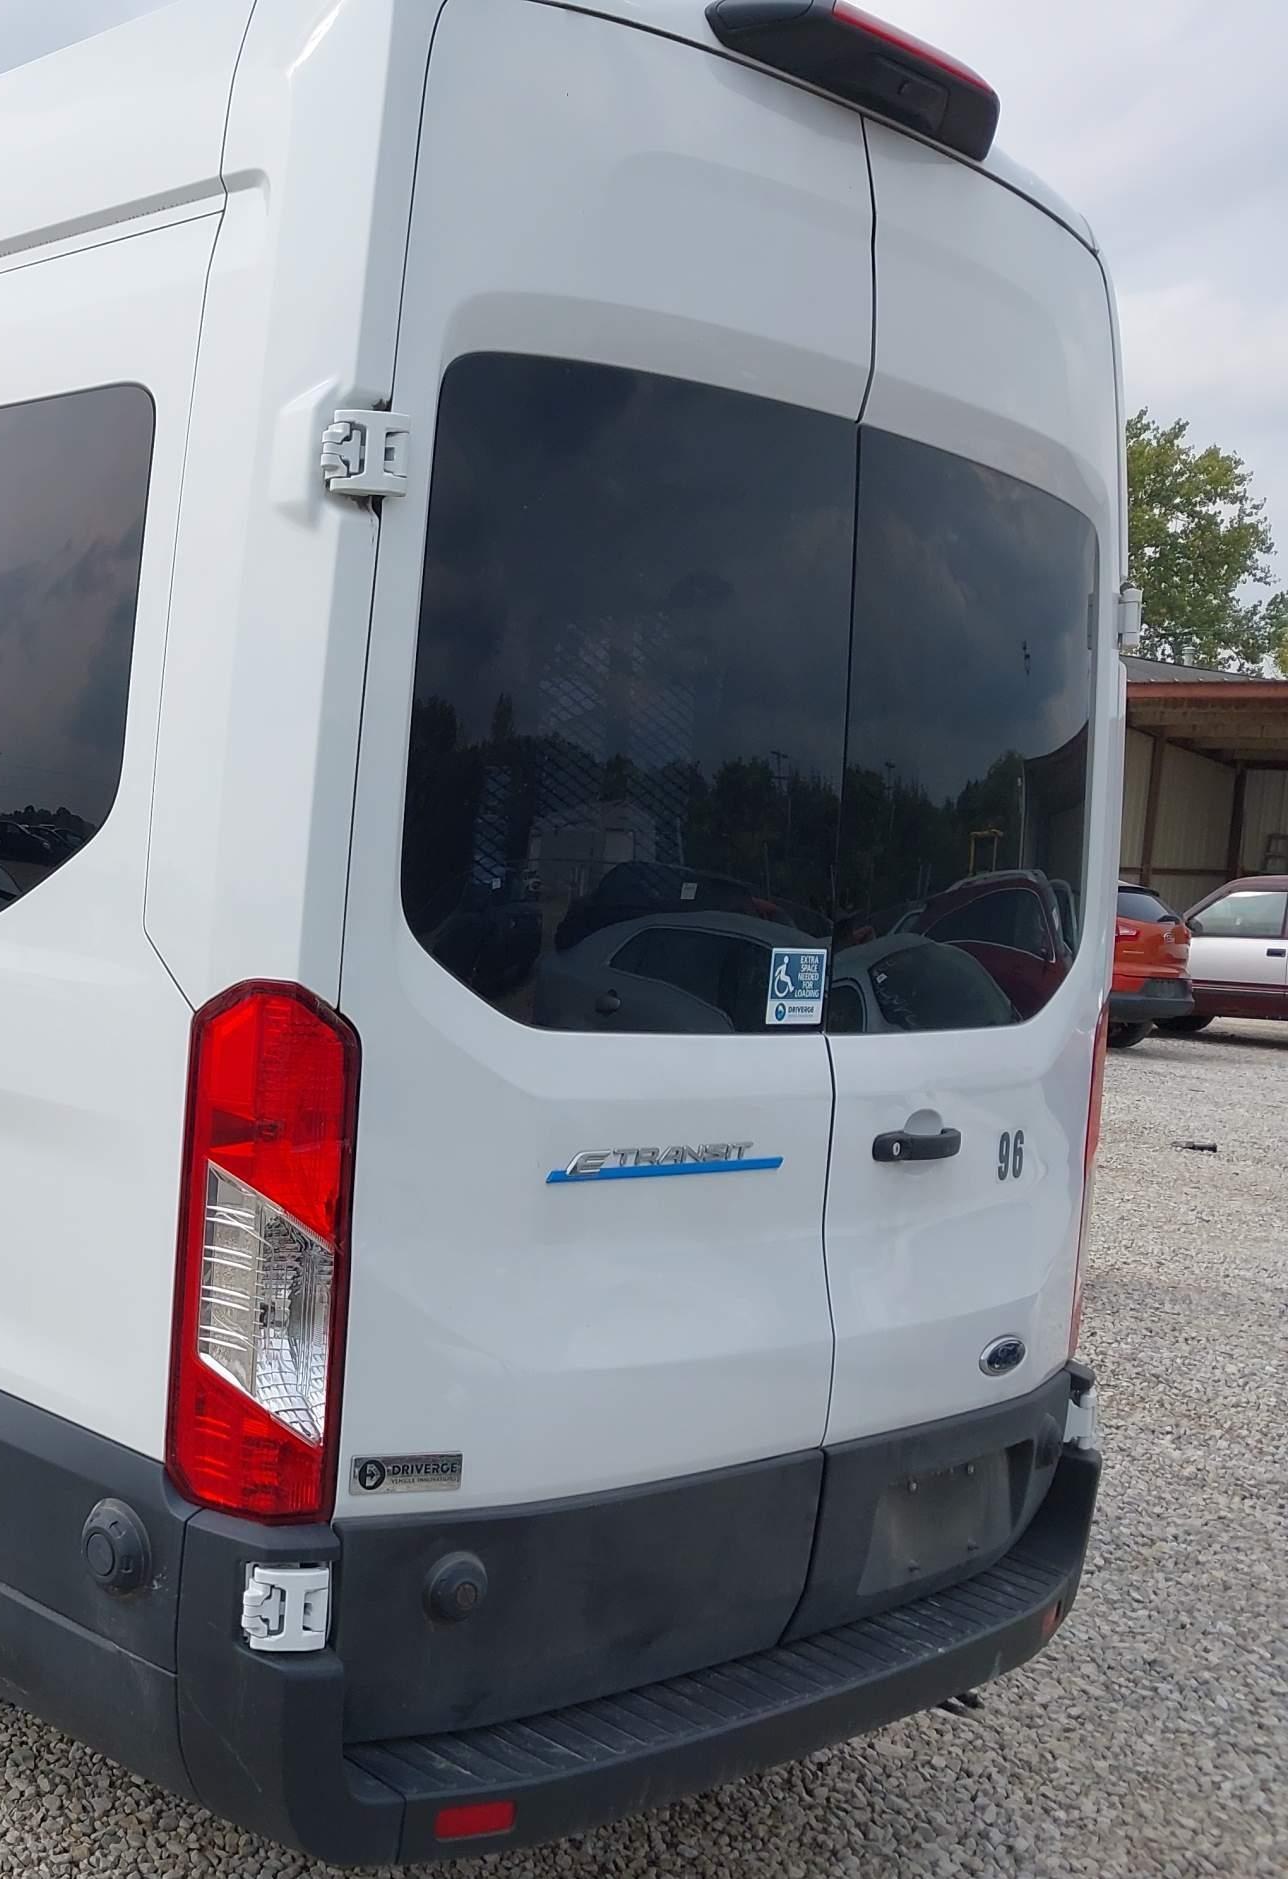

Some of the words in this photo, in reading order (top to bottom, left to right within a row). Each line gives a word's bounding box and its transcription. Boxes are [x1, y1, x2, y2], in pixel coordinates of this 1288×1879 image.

[800, 955, 819, 963] EXTRA
[801, 964, 818, 972] SPACE
[802, 981, 813, 989] FOR
[794, 989, 819, 997] LOADING
[788, 1006, 814, 1014] DRIVERGE
[998, 1130, 1024, 1180] 96
[392, 1462, 457, 1475] DRIVERGE
